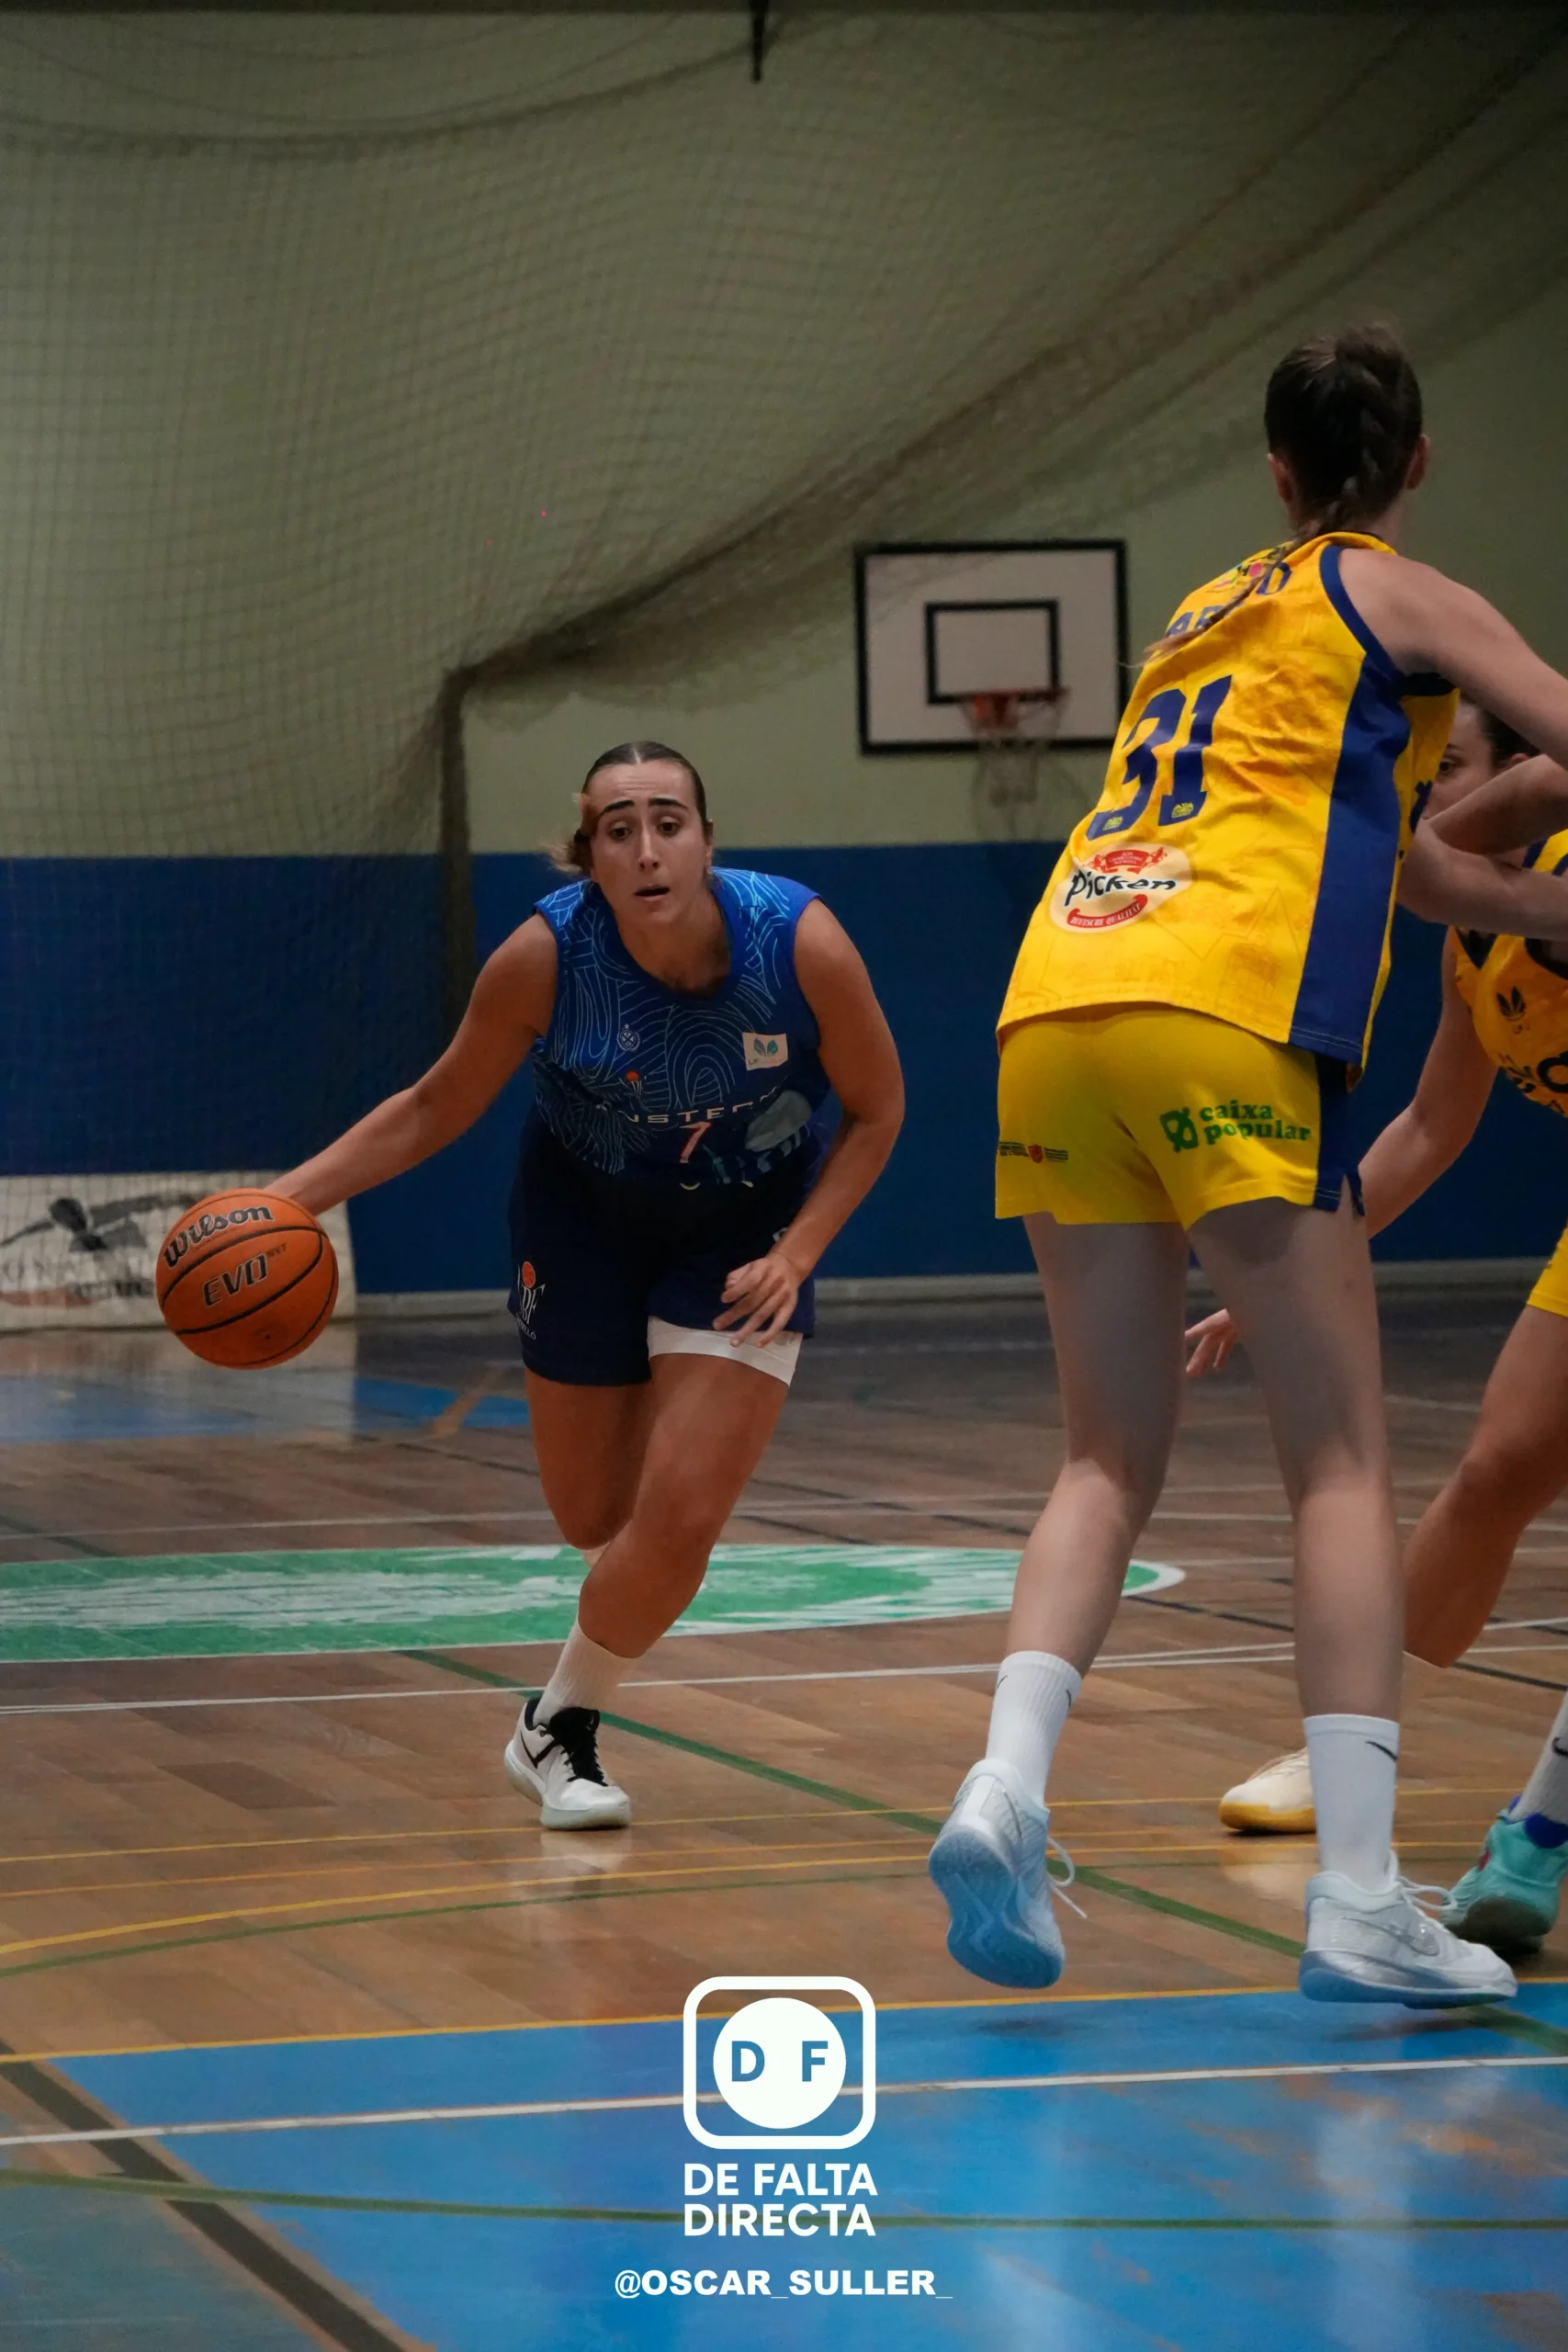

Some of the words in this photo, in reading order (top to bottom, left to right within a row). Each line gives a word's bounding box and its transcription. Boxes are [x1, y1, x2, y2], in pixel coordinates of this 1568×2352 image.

[1086, 673, 1234, 841] 31
[1200, 1100, 1273, 1122] caixa
[1204, 1120, 1312, 1146] popular
[679, 1122, 713, 1164] 7
[163, 1204, 274, 1269] Wilson
[202, 1253, 268, 1307] EVO
